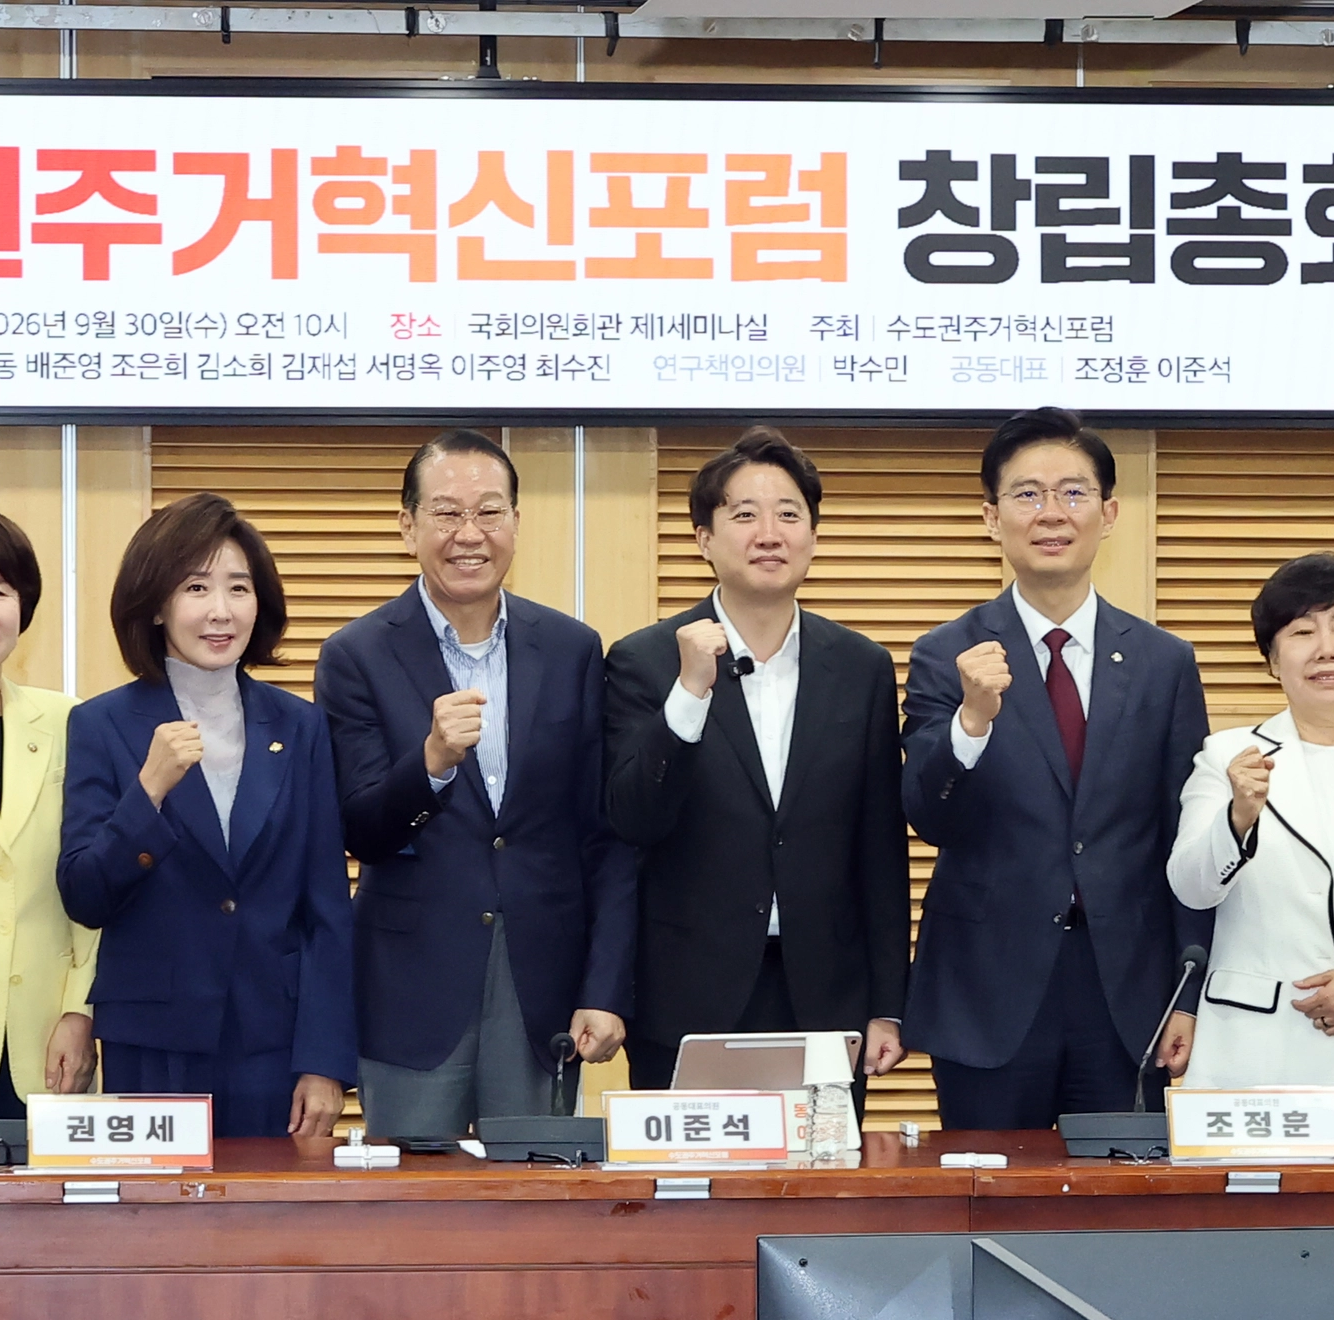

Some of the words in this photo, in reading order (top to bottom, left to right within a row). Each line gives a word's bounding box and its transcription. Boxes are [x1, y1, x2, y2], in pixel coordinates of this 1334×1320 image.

[75, 311, 116, 338] 9월
[125, 311, 227, 339] 30일(수)
[235, 312, 285, 339] 오전
[294, 312, 346, 339] 10시
[391, 313, 442, 340] 장소
[468, 313, 623, 340] 국회의원회관
[630, 313, 767, 341] 제1세미나실
[810, 314, 859, 341] 주최
[887, 315, 1113, 342] 수도권주거혁신포럼
[26, 352, 101, 379] 배준영
[110, 352, 187, 380] 조은희
[197, 353, 271, 380] 김소희
[282, 353, 356, 380] 김재섭
[366, 353, 443, 381] 서명옥
[452, 353, 526, 381] 이주영
[536, 354, 610, 381] 최수진
[653, 354, 805, 382] 연구책임의원
[834, 355, 907, 382] 박수민
[950, 356, 1048, 383] 공동대표
[1075, 356, 1150, 383] 조정훈
[1158, 356, 1230, 383] 이준석
[67, 1115, 174, 1142] 권영세
[645, 1114, 750, 1142] 이준석
[1206, 1110, 1310, 1137] 조정훈
